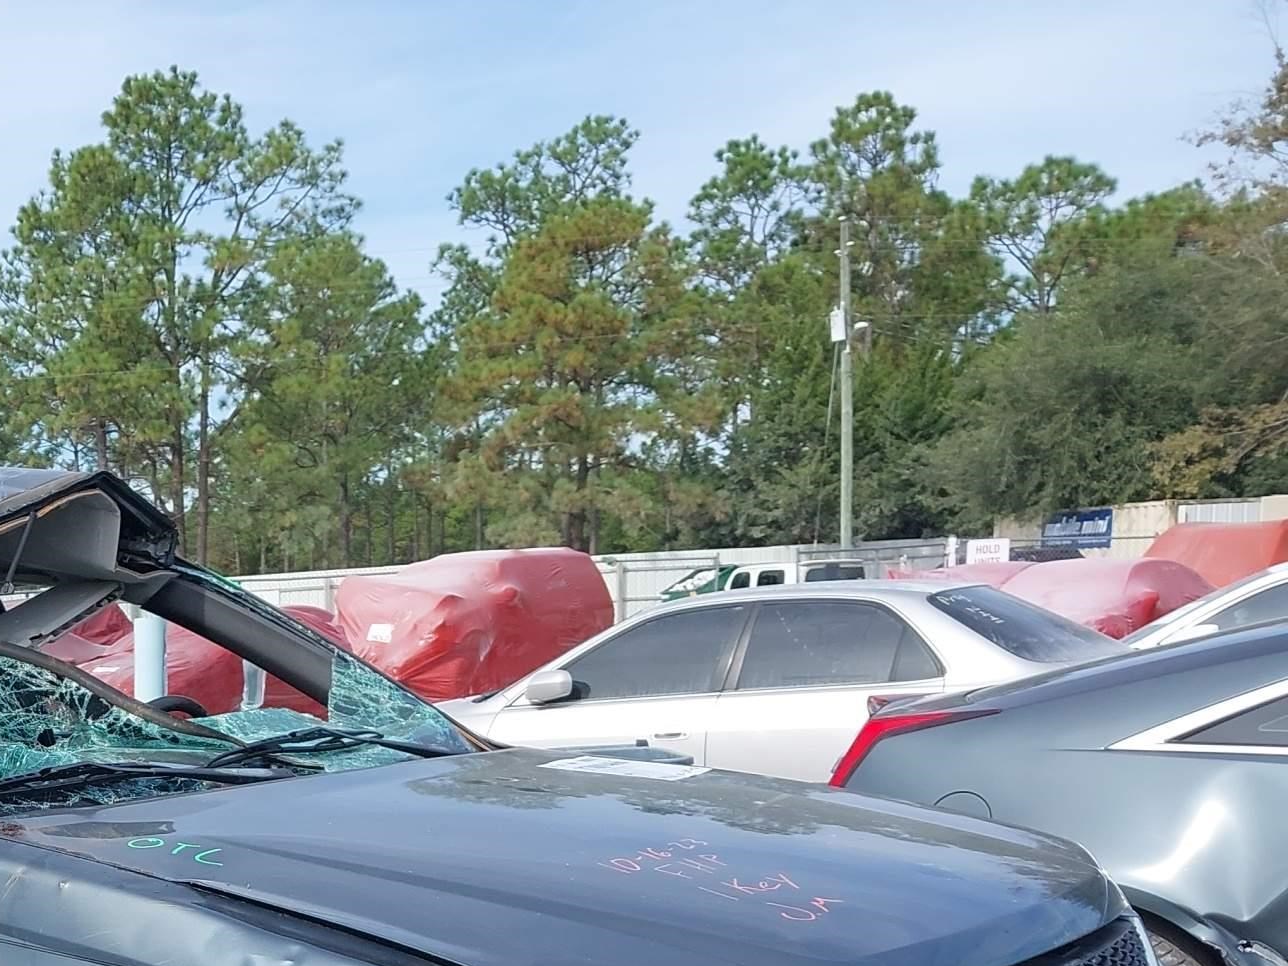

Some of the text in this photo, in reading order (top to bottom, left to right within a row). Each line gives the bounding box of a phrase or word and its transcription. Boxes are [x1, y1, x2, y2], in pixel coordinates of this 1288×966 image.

[975, 543, 1001, 555] HOLD
[127, 837, 224, 867] OTC
[597, 837, 709, 875] 10-16-23
